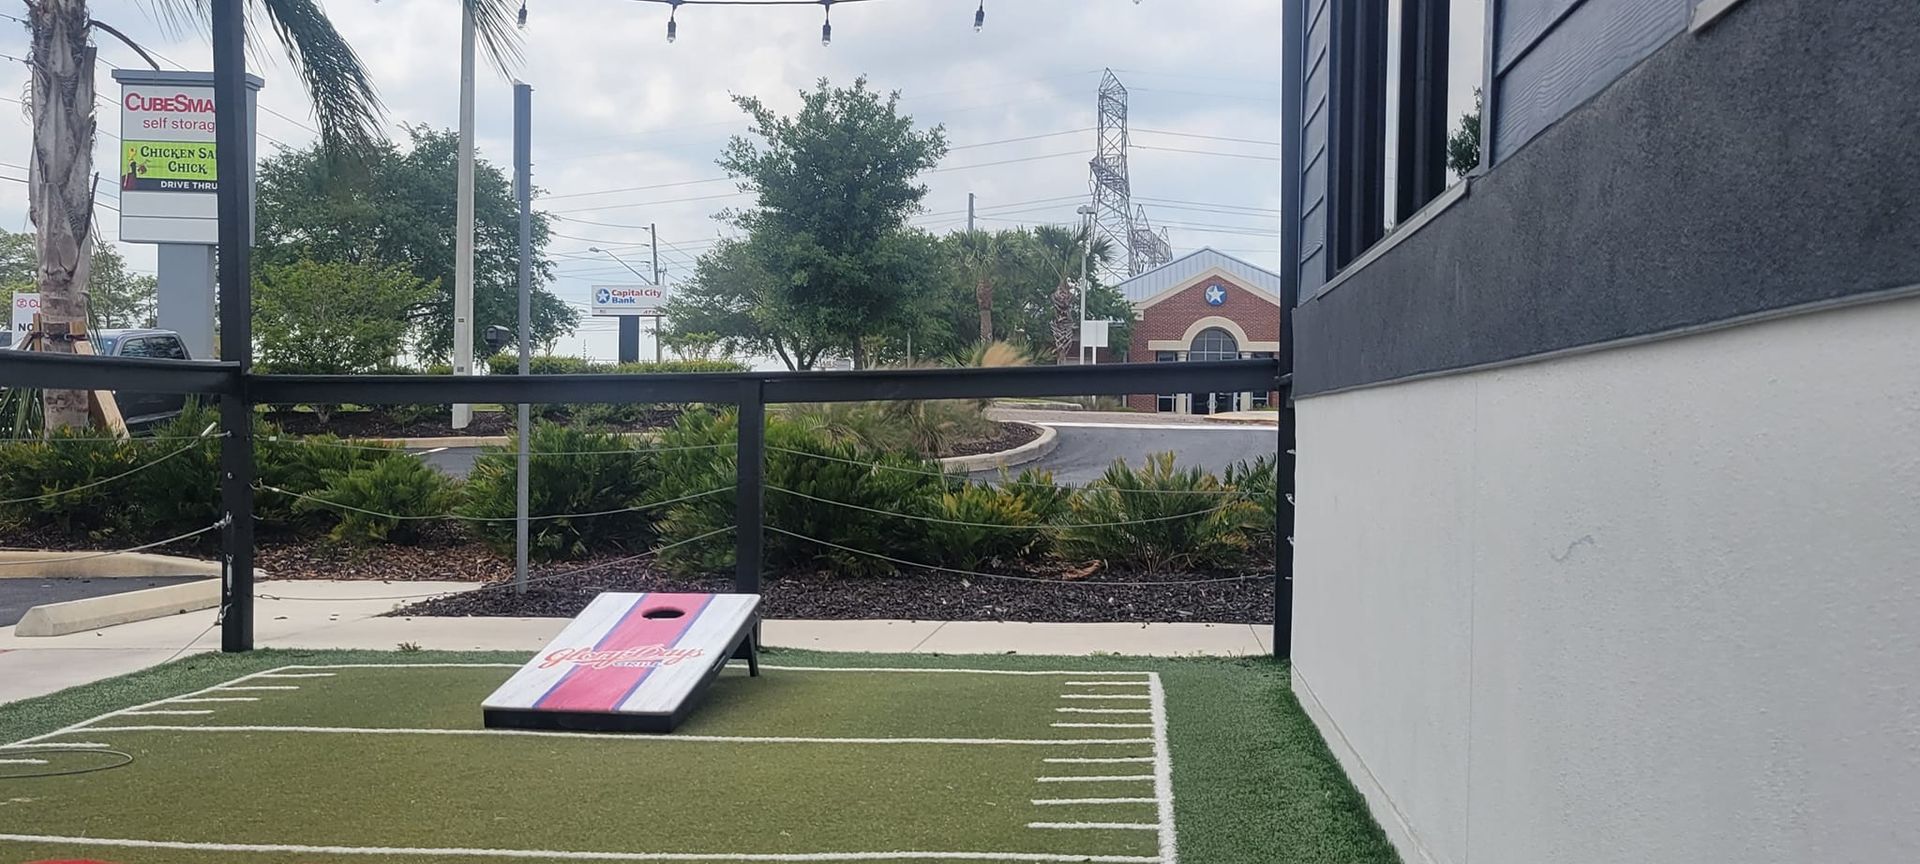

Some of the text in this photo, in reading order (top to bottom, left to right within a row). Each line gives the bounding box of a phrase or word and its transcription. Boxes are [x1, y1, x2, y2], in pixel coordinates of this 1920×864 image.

[125, 92, 216, 113] CUBESMA
[143, 117, 215, 133] self storag
[198, 147, 216, 159] SA
[168, 161, 207, 174] CHICK
[160, 180, 218, 190] DRIVE THRU
[611, 289, 662, 298] Capital City
[611, 296, 636, 304] Bank
